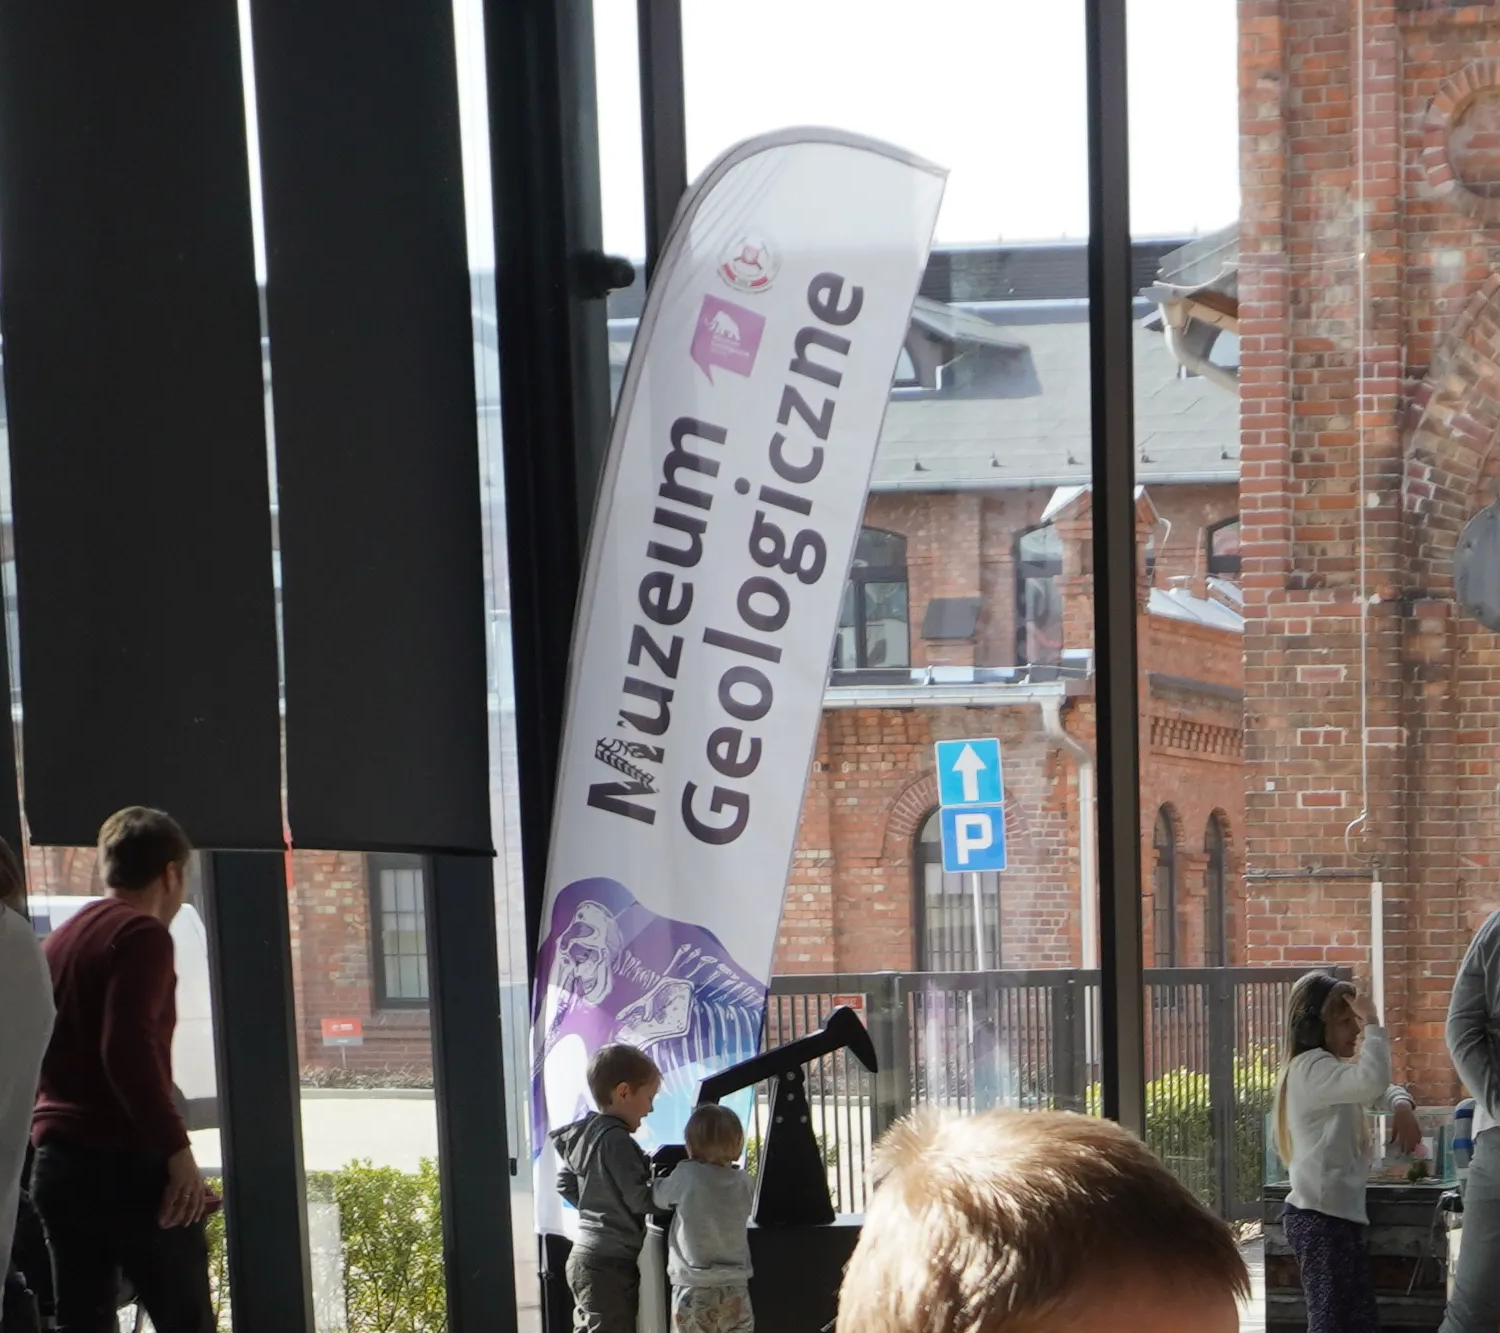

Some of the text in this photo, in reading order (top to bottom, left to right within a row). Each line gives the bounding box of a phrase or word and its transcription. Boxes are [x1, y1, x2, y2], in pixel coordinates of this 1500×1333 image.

[587, 413, 730, 824] Muzeum
[681, 269, 866, 847] Geologiczne
[954, 814, 994, 866] P
